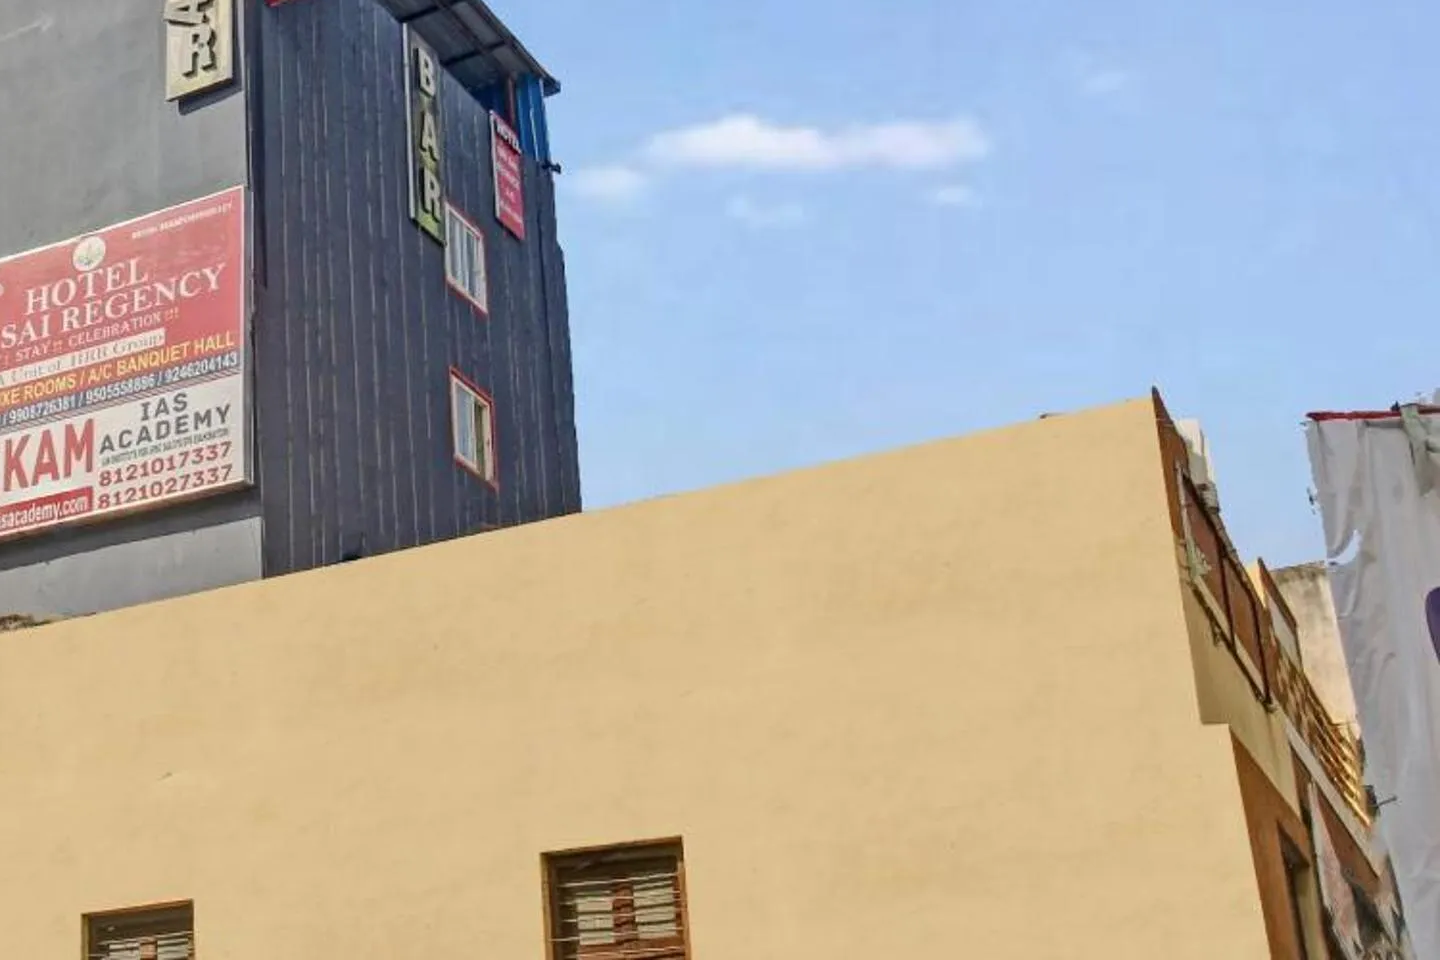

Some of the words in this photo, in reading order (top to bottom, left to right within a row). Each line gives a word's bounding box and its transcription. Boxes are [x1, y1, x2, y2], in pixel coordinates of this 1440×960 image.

[417, 47, 441, 224] BAR
[1, 314, 50, 349] SAI
[62, 263, 227, 333] REGENCY
[24, 257, 148, 316] HOTEL
[25, 373, 77, 403] ROOMS
[88, 364, 112, 384] A/C
[116, 341, 191, 376] BANQUET
[192, 333, 235, 354] HALL
[100, 403, 230, 454] ACADEMY
[140, 392, 188, 421] IAS
[98, 464, 232, 509] 8121027337
[99, 441, 232, 486] 8121017337
